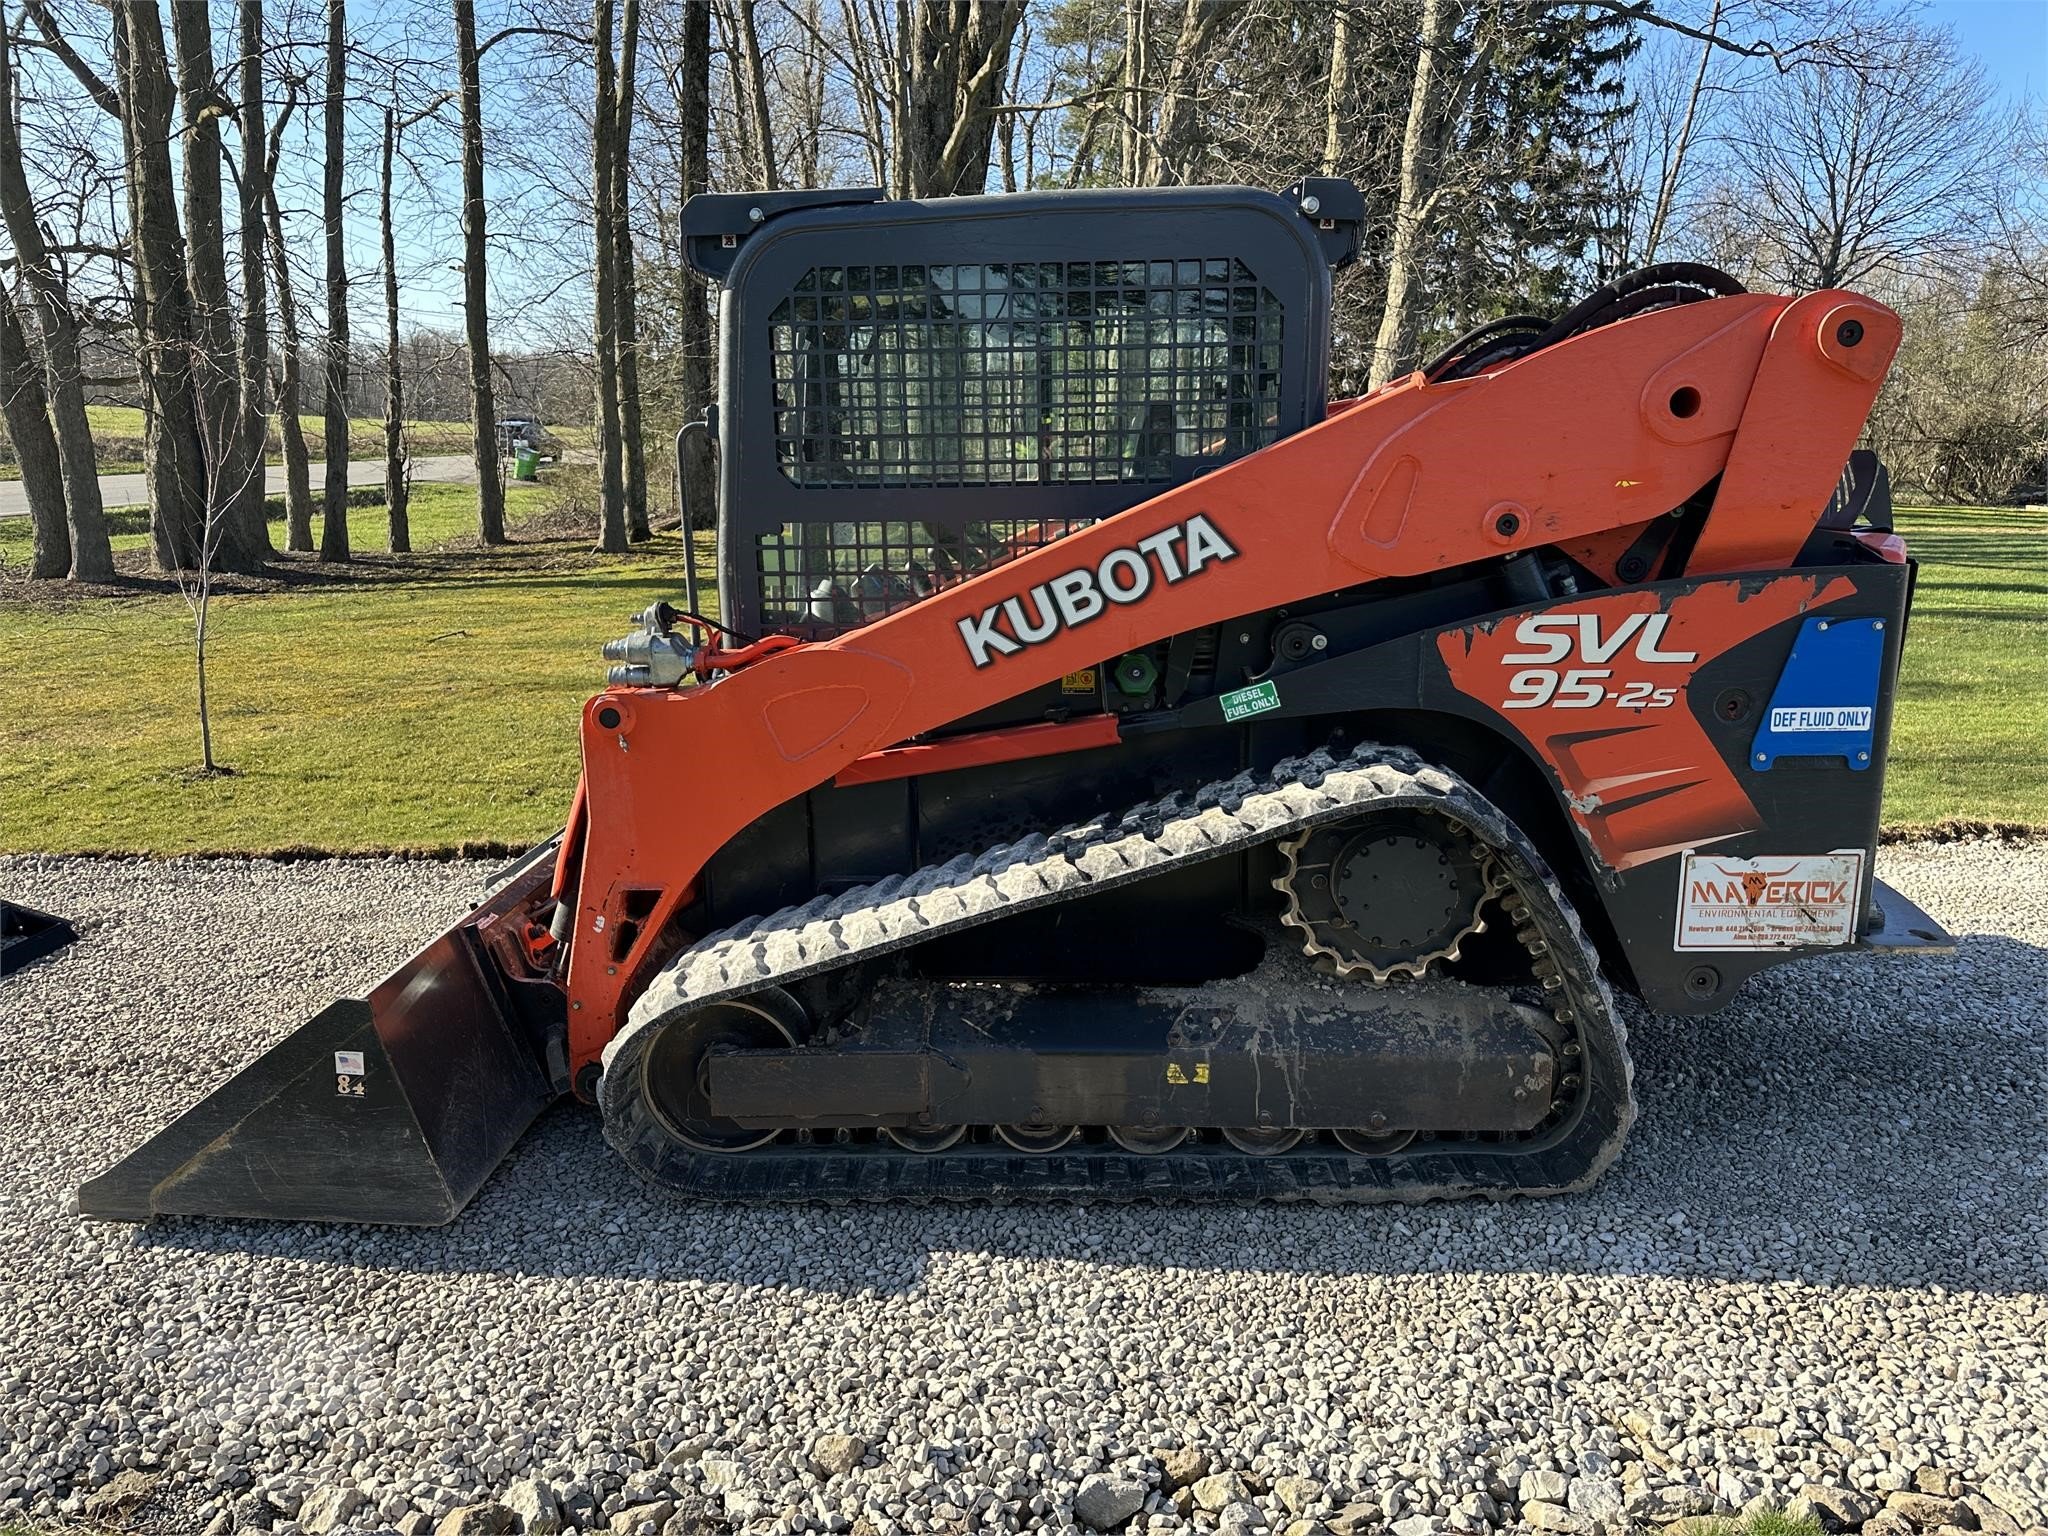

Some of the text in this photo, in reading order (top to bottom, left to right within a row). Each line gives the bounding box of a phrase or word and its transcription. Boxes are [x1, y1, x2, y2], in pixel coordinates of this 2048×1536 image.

[957, 514, 1237, 668] KUBOTA
[1501, 613, 1699, 664] SVL
[1232, 688, 1264, 705] DIESEL
[1227, 696, 1275, 718] FUEL ONLY
[1774, 711, 1869, 727] DEF FLUID ONLY
[1699, 909, 1778, 918] ENVIRONMENTAL
